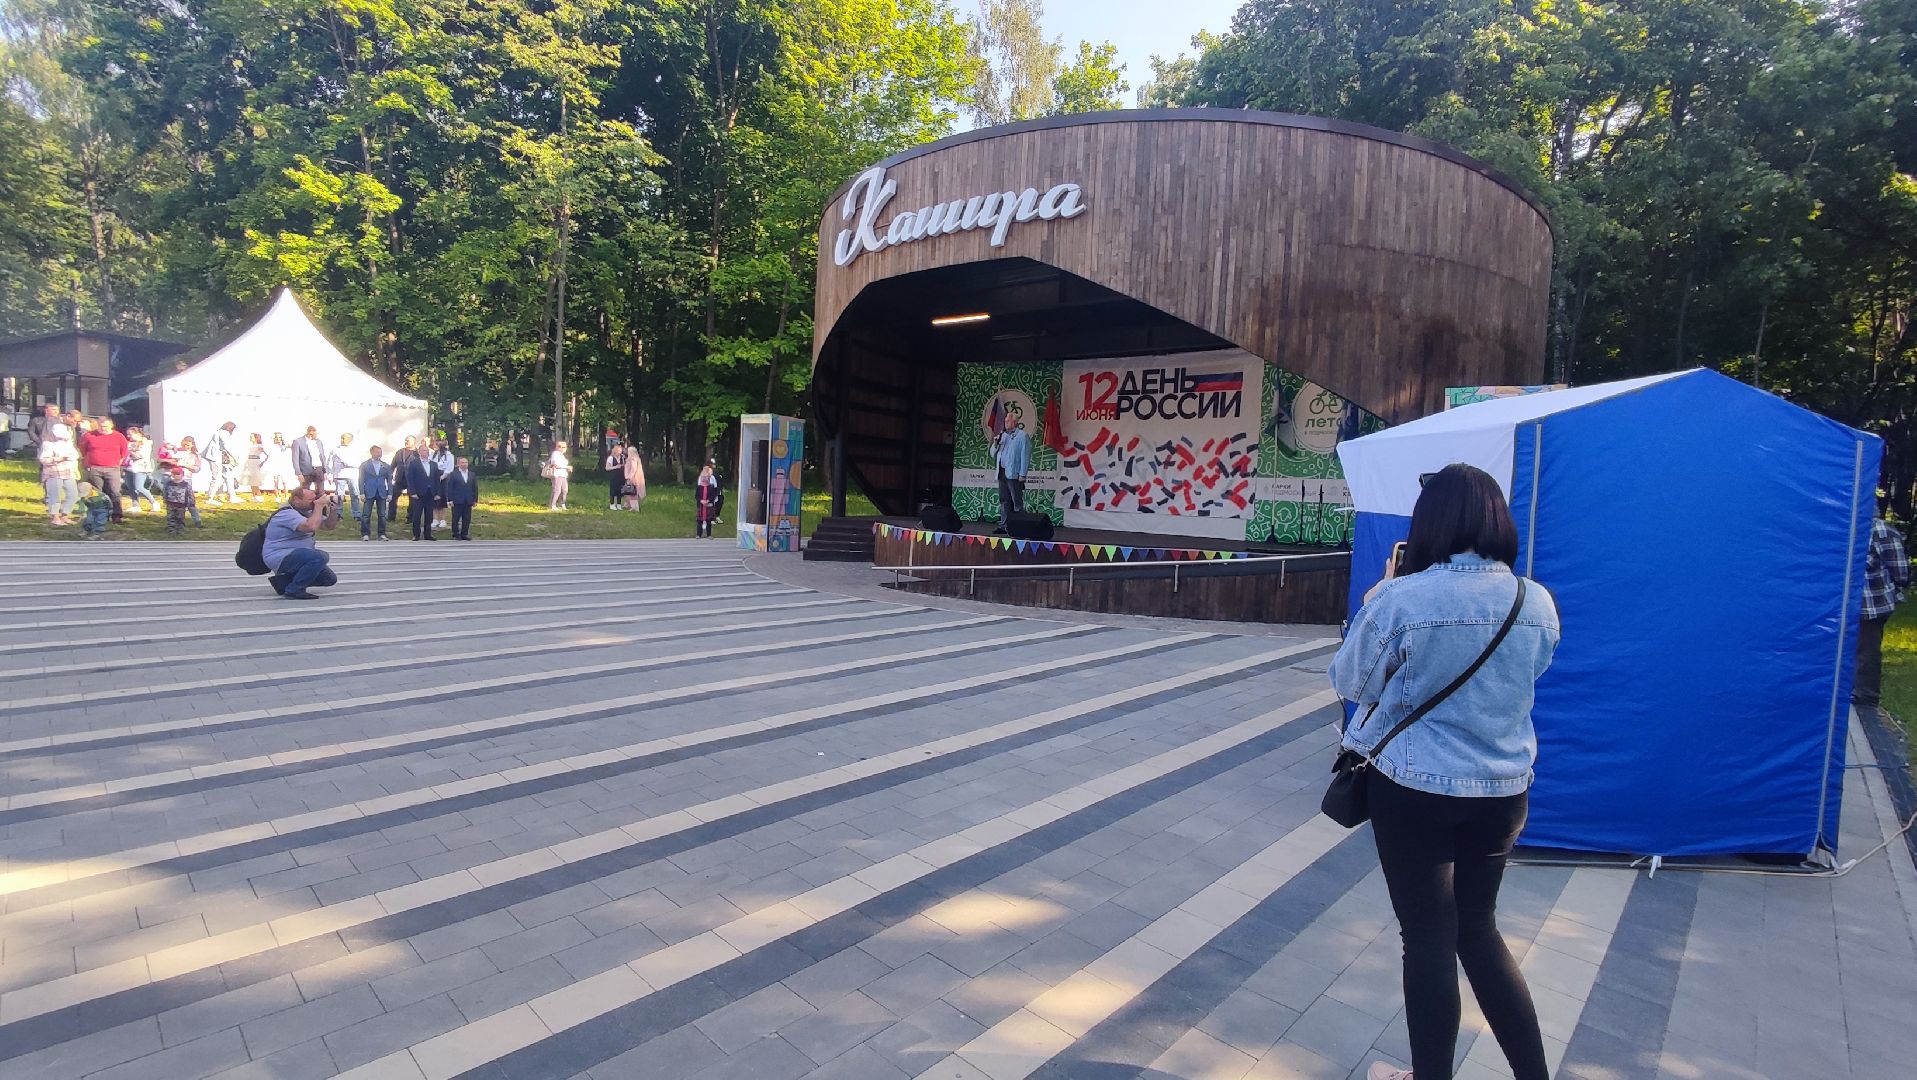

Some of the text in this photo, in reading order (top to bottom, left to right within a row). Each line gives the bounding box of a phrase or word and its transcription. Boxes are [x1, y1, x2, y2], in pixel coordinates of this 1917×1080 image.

[834, 167, 1087, 266] Кашира
[1078, 371, 1119, 410] 12
[1117, 368, 1199, 395] ДЕНЬ
[1076, 409, 1117, 421] ИЮНЯ
[1117, 391, 1242, 420] РОССИИ
